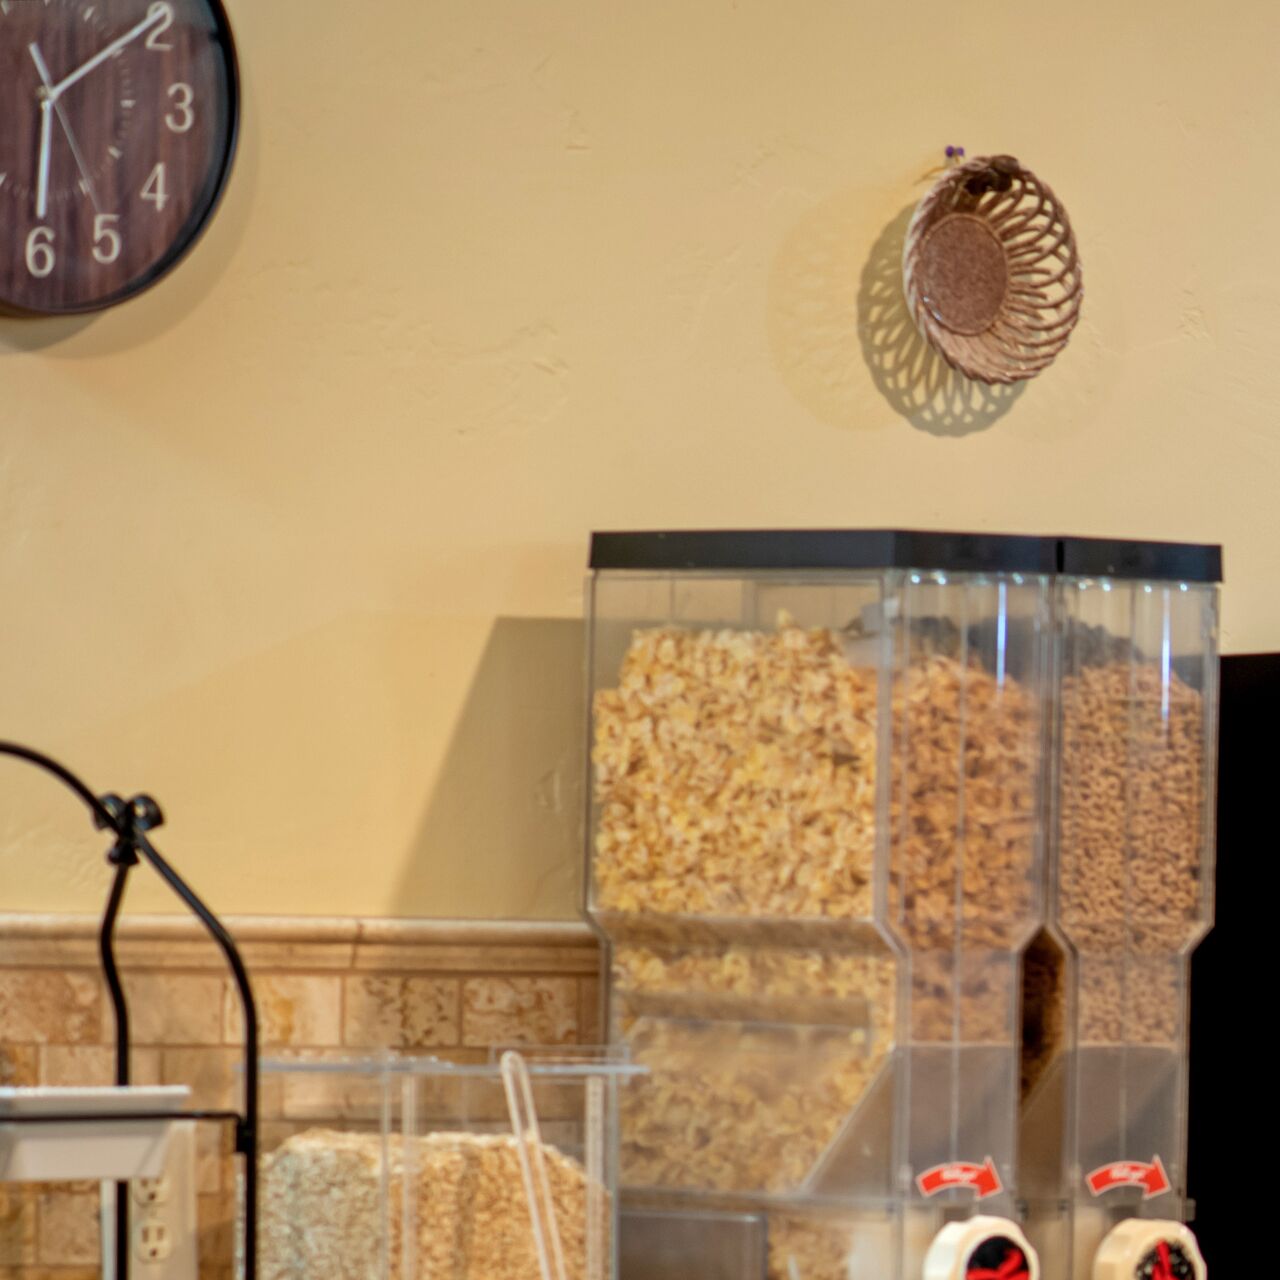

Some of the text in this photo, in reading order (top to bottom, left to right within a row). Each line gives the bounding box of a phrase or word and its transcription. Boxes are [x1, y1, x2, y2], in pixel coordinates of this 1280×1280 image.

[145, 1, 174, 49] 2
[165, 83, 194, 132] 3
[140, 162, 169, 212] 4
[25, 226, 55, 278] 6
[92, 213, 121, 264] 5
